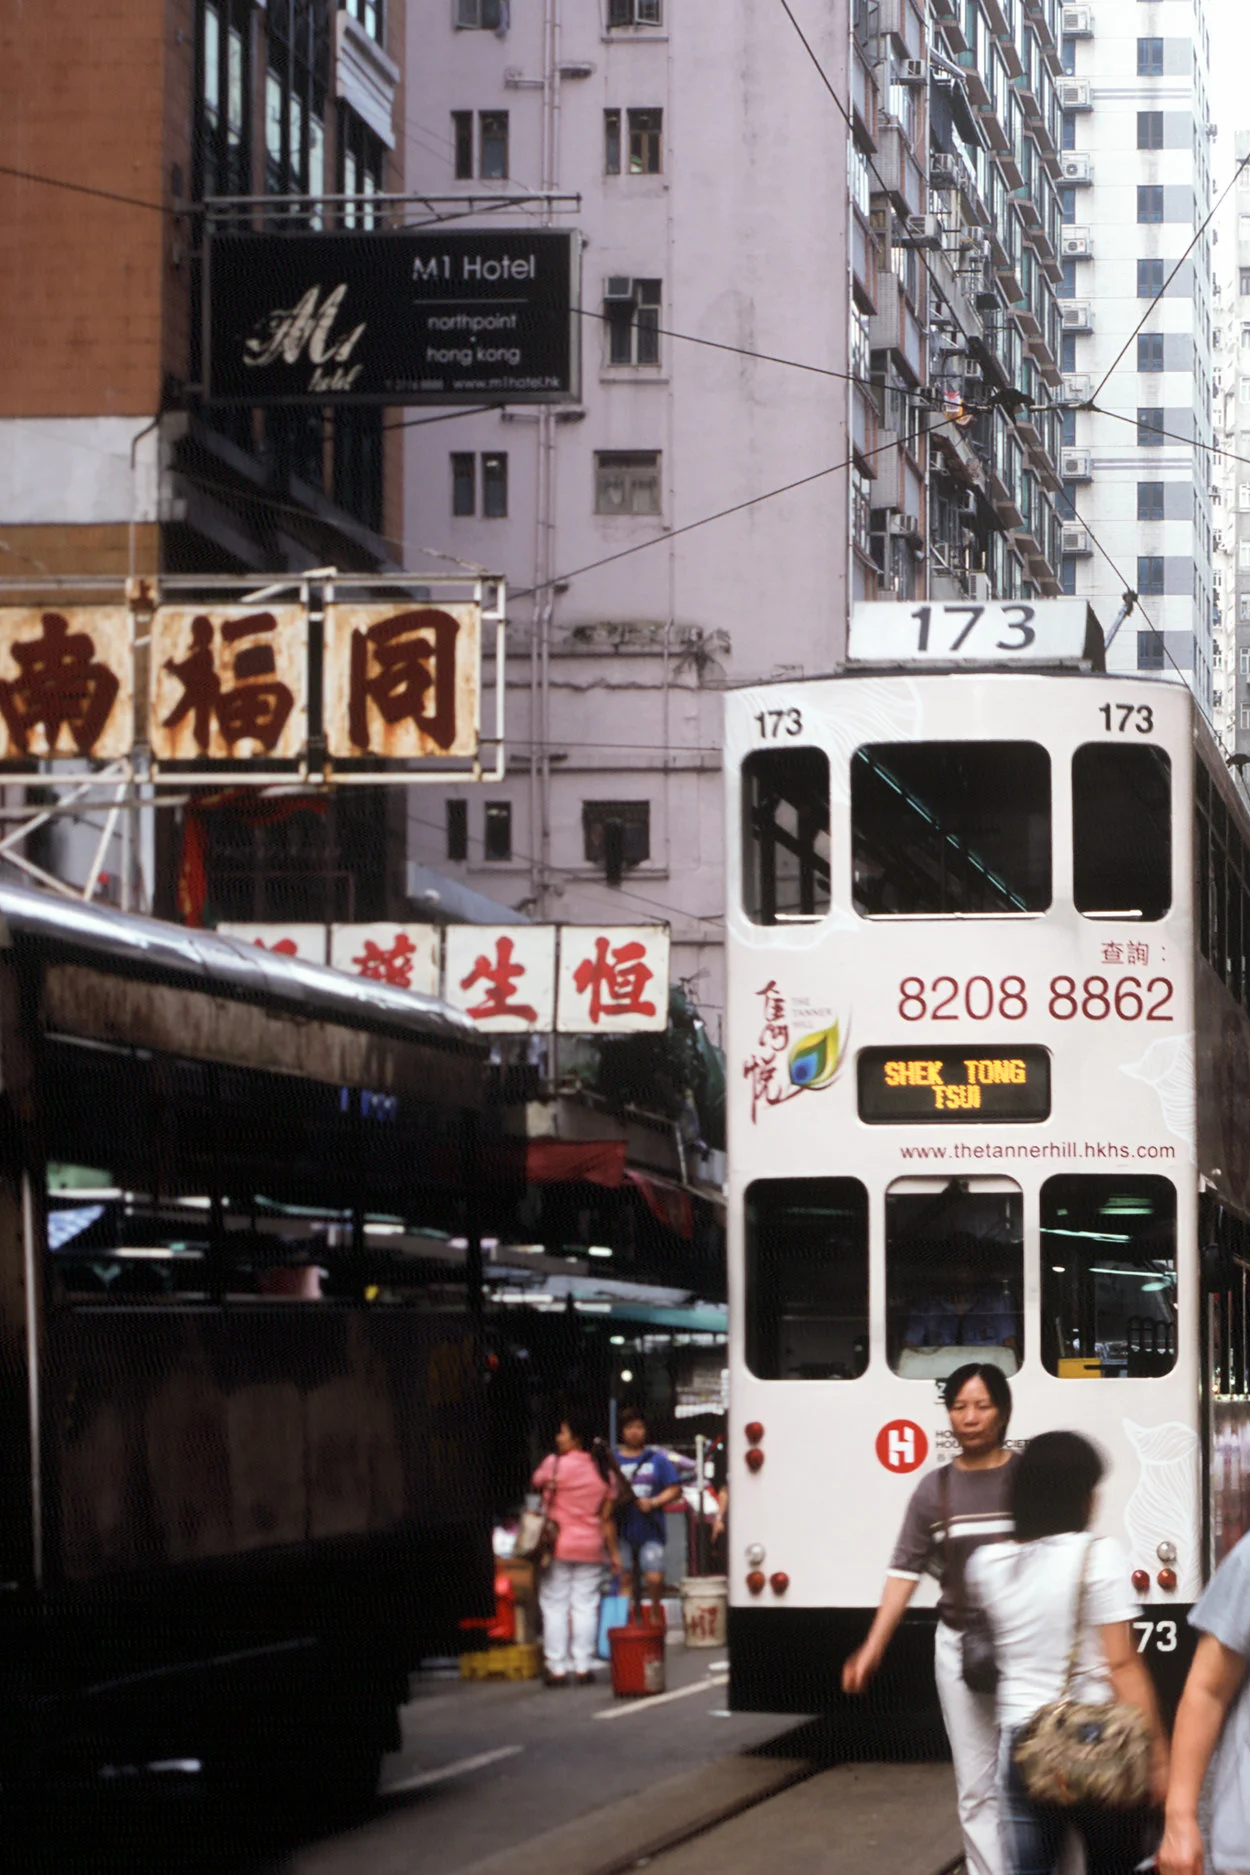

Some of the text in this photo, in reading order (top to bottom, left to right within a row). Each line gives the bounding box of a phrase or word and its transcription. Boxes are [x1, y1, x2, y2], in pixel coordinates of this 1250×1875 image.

[412, 255, 536, 280] M1 Hotel
[428, 313, 517, 332] northpoint
[426, 344, 520, 365] hong kong
[911, 605, 1036, 652] 173
[754, 708, 803, 739] 173
[1098, 703, 1154, 734] 173
[899, 975, 1174, 1021] 8208 8862
[791, 1008, 833, 1017] TANNER
[884, 1060, 1027, 1086] SHEK TONG
[934, 1085, 981, 1109] TSUI
[900, 1142, 1176, 1161] www.thetannerhill.hkhs.com
[1132, 1620, 1177, 1653] 73
